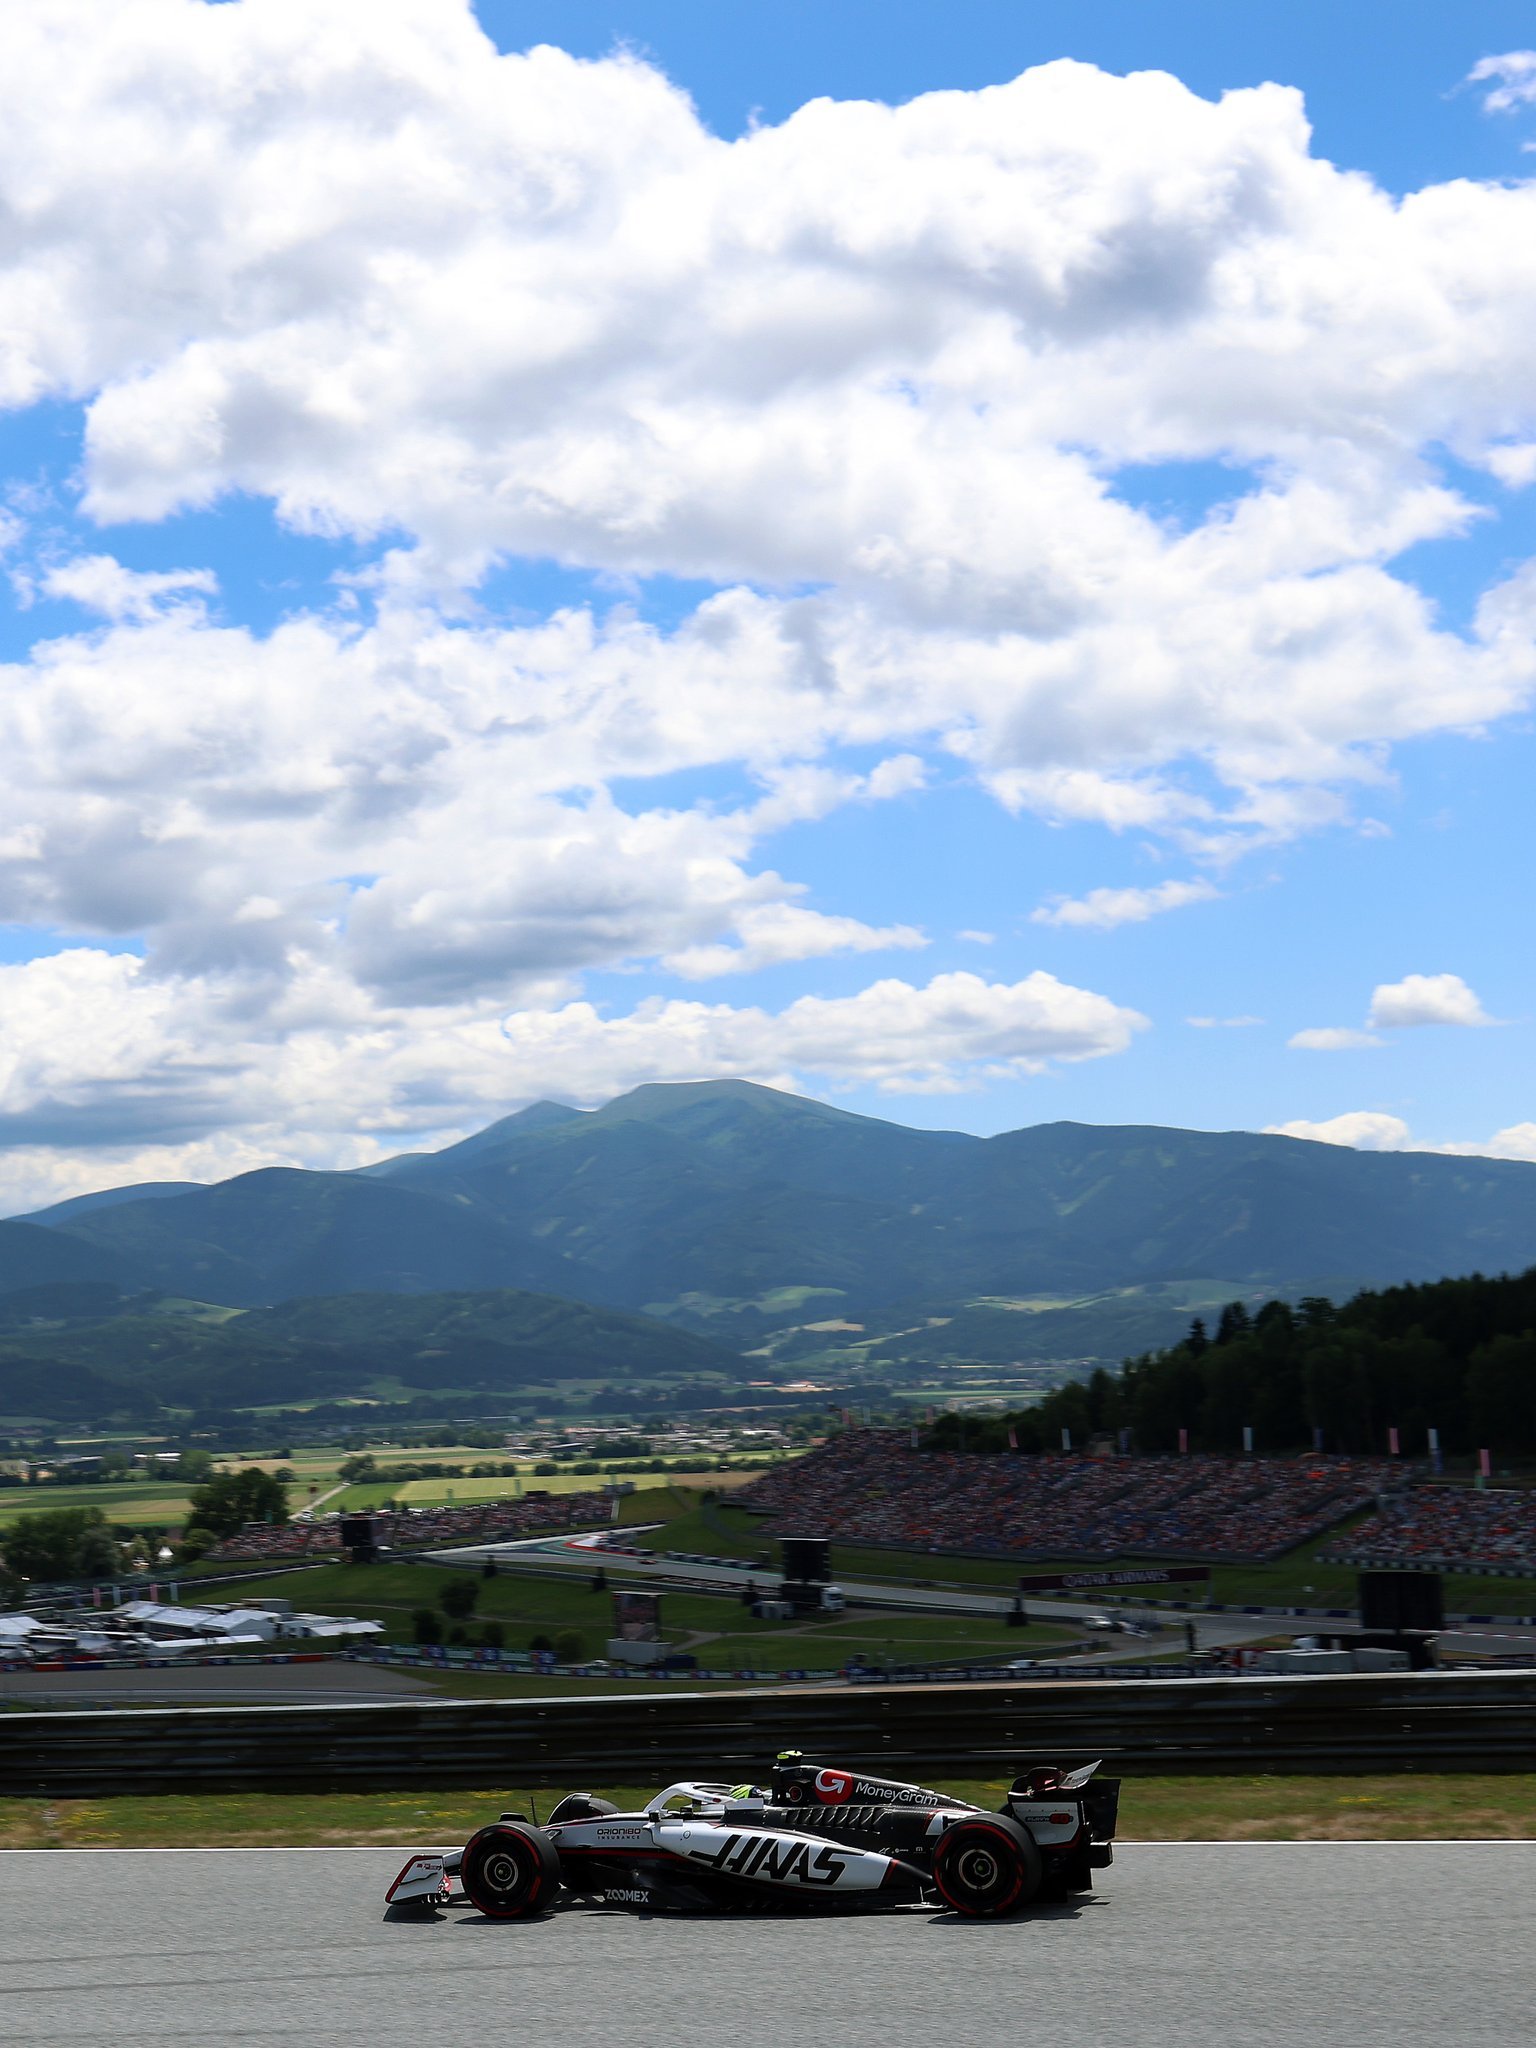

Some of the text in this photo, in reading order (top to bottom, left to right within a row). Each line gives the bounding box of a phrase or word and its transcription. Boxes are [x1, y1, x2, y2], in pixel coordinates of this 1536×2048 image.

[855, 1782, 938, 1806] MoneyGram
[688, 1834, 865, 1885] HAAS
[604, 1888, 649, 1903] ZOOMEX
